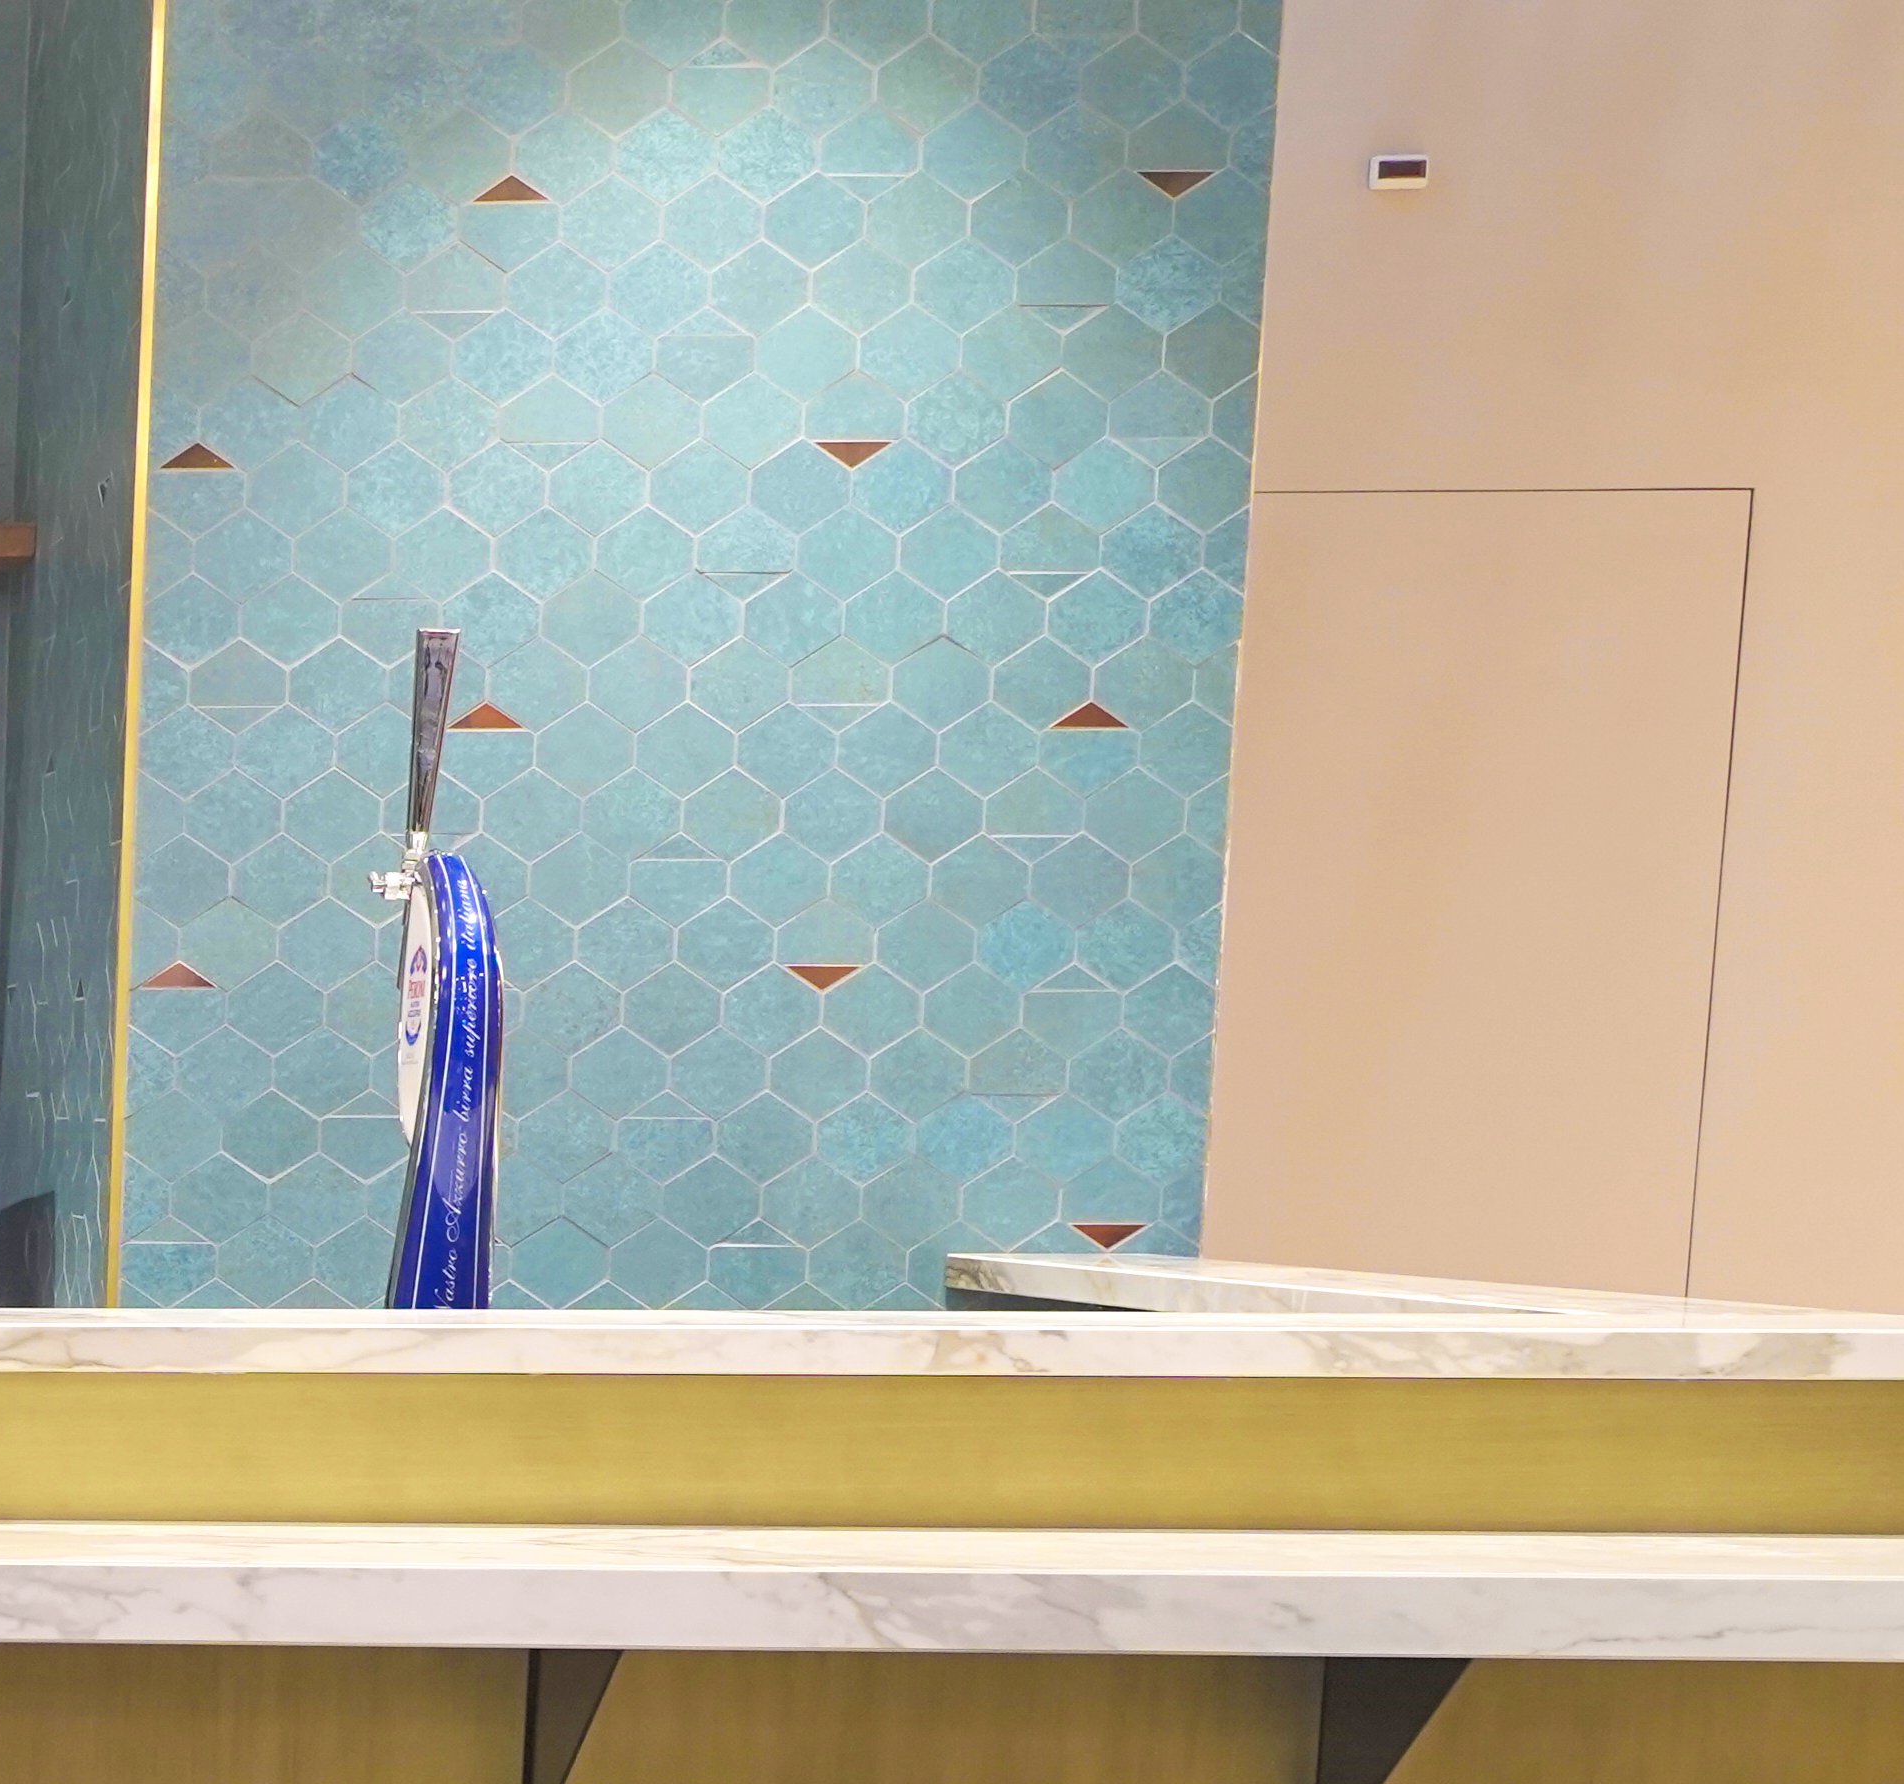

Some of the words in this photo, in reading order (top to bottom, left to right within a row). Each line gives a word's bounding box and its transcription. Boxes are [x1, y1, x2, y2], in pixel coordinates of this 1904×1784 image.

[456, 879, 477, 951] italiana
[459, 958, 481, 1058] superiore
[452, 1066, 474, 1122] birra
[442, 1130, 469, 1243] Azzurro
